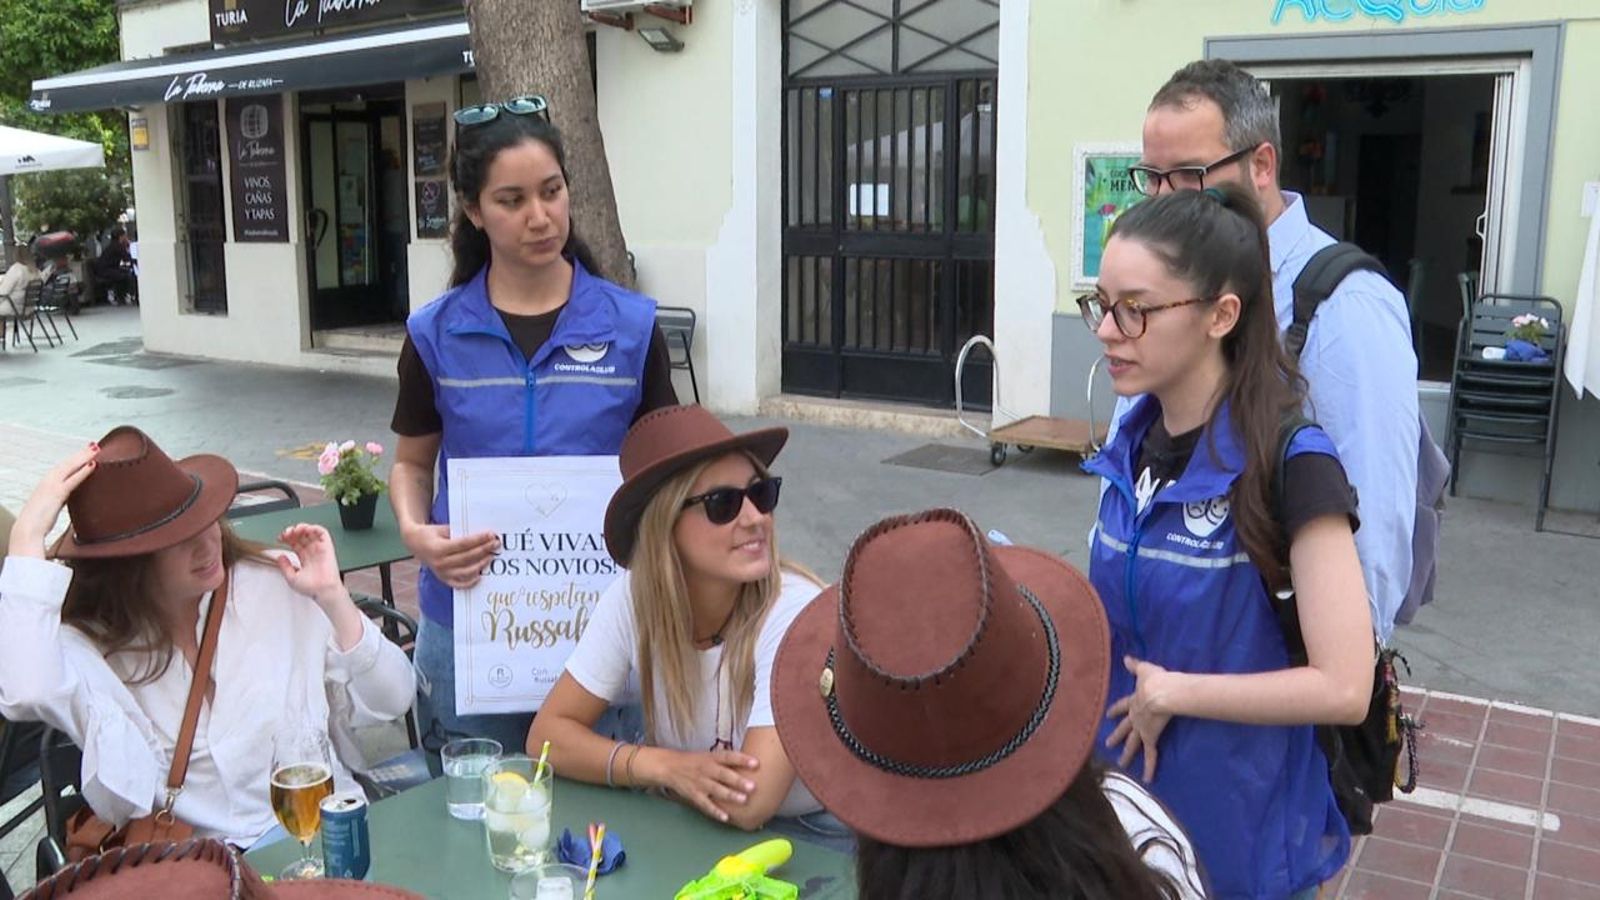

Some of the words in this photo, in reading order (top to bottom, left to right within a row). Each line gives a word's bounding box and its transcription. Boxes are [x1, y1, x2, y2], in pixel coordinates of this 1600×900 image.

[215, 9, 248, 27] TURIA
[164, 75, 182, 101] La
[1110, 179, 1135, 192] MEN
[245, 190, 272, 204] CAÑAS
[251, 208, 275, 220] TAPAS
